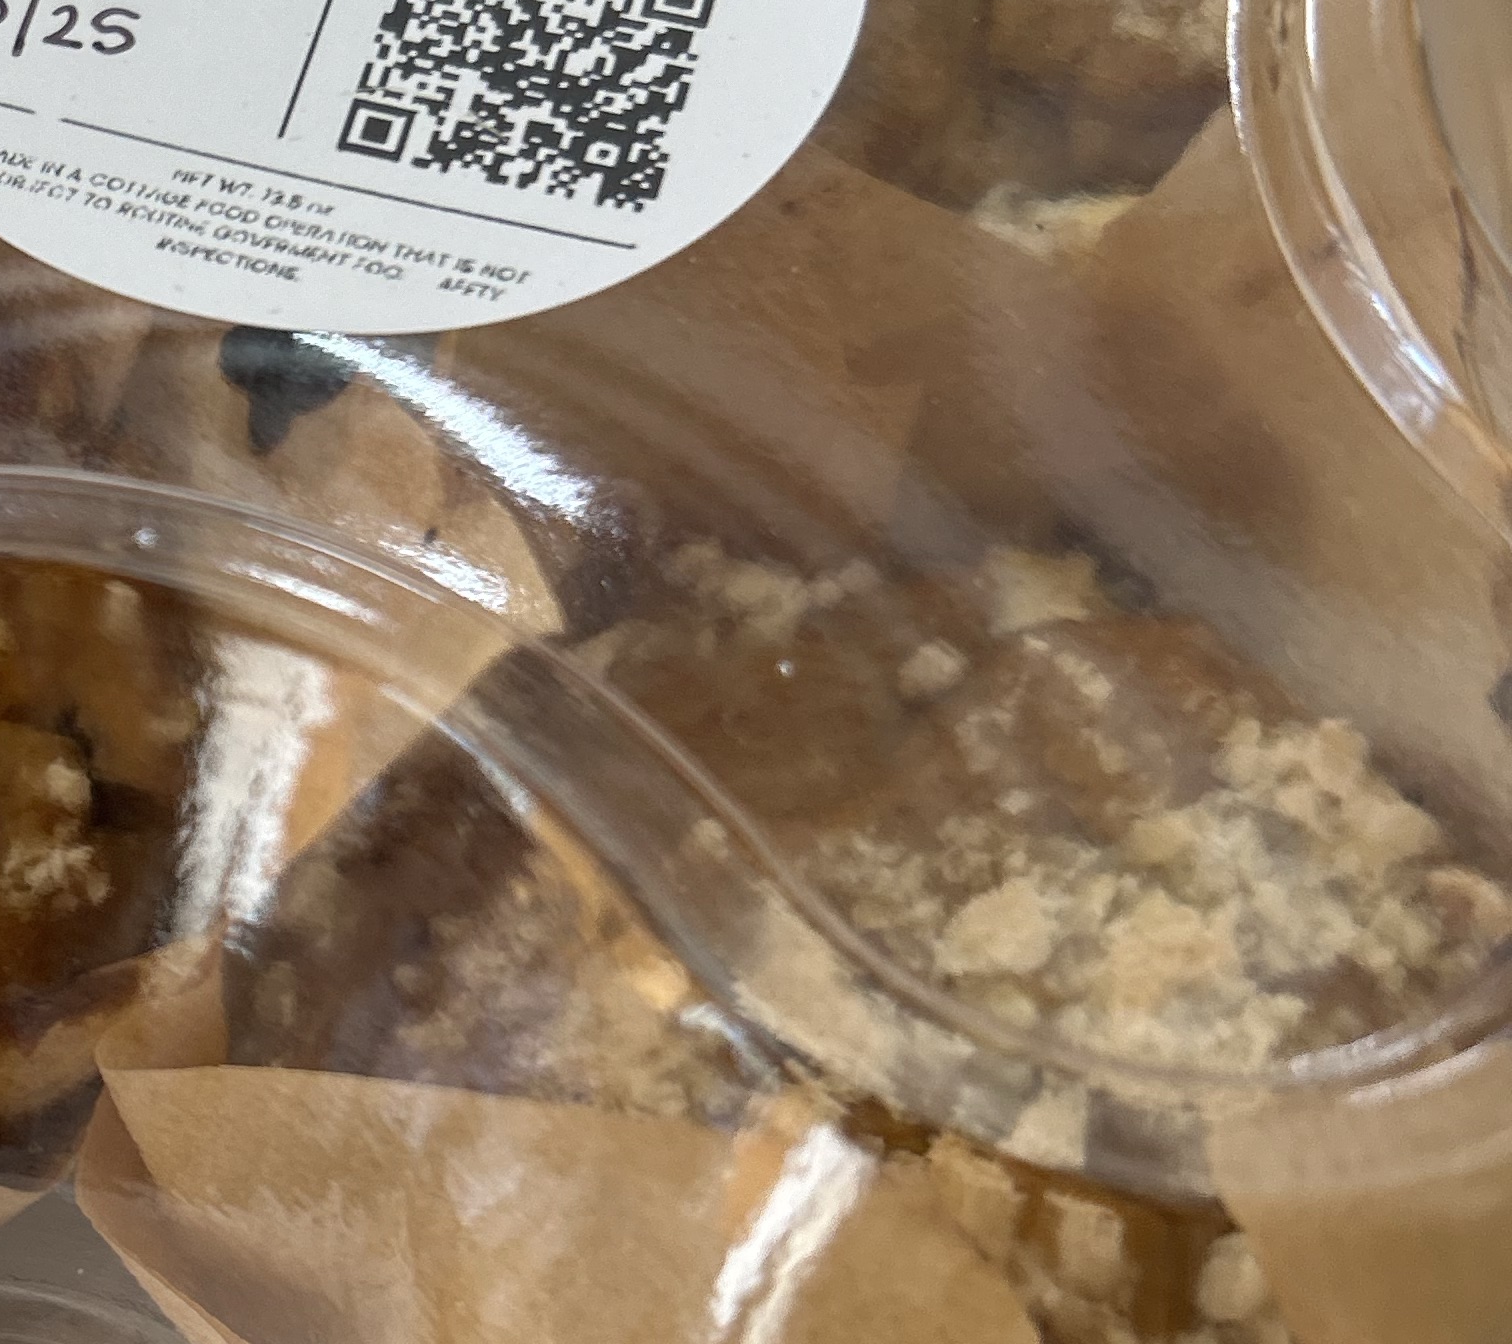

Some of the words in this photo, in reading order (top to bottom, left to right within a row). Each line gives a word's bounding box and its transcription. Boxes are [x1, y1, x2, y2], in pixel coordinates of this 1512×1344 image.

[66, 167, 82, 182] A
[194, 196, 261, 225] FOOD
[437, 276, 506, 302] AFETY
